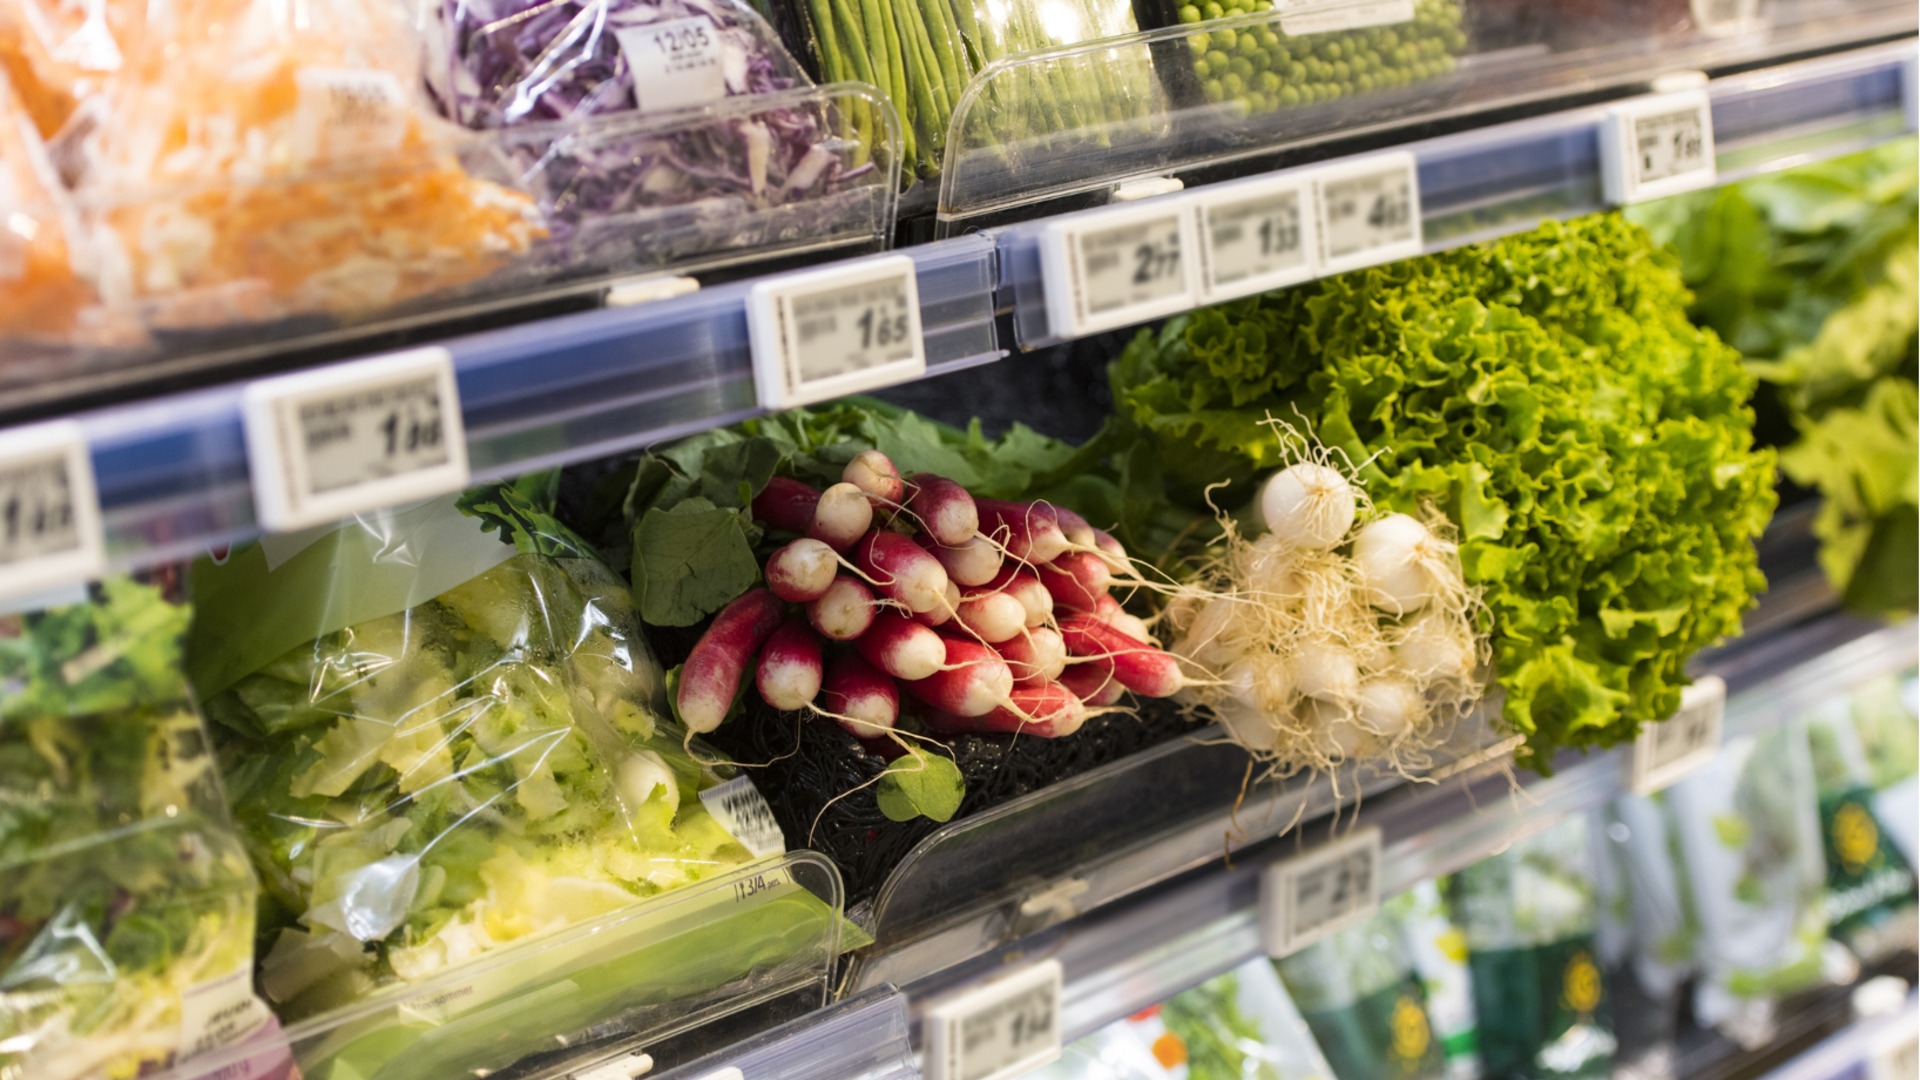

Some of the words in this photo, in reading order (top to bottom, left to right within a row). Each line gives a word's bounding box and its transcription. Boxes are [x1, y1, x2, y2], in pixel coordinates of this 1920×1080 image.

[653, 26, 710, 55] 12/05
[1132, 243, 1181, 285] 277
[856, 306, 909, 349] 165
[747, 875, 767, 897] 3/4
